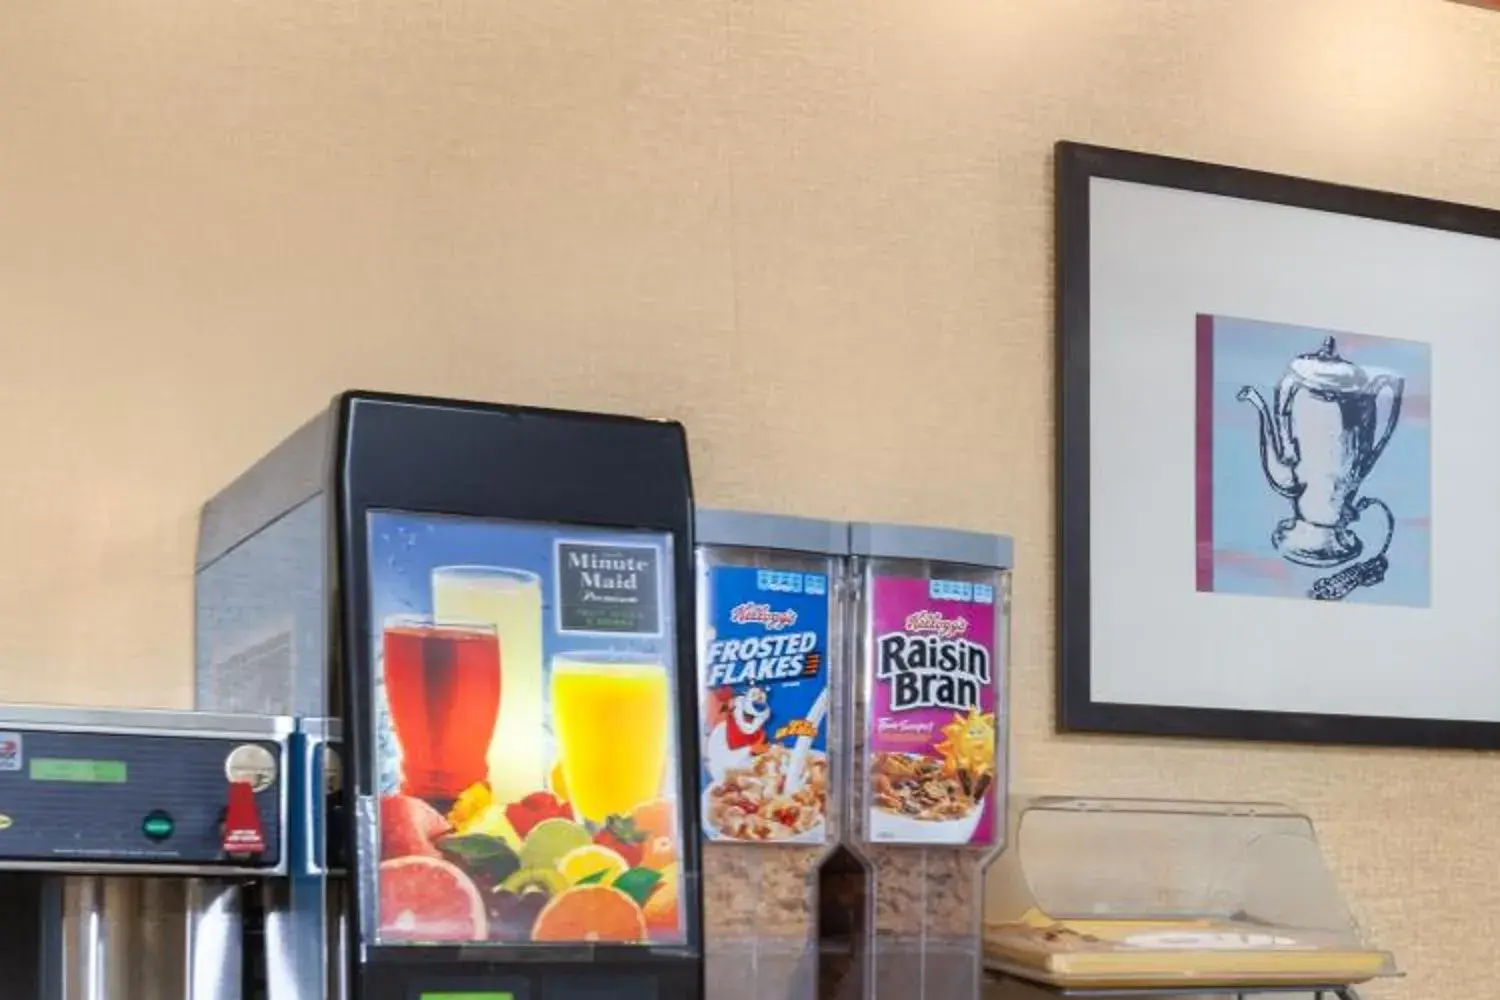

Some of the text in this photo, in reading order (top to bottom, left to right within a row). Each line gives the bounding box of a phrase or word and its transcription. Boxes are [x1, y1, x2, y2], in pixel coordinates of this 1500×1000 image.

[568, 551, 649, 572] Minute
[581, 571, 638, 589] Maid
[709, 632, 817, 664] FROSTED
[879, 633, 990, 683] Raisin
[708, 655, 804, 686] FLAKES
[892, 671, 981, 710] Bran
